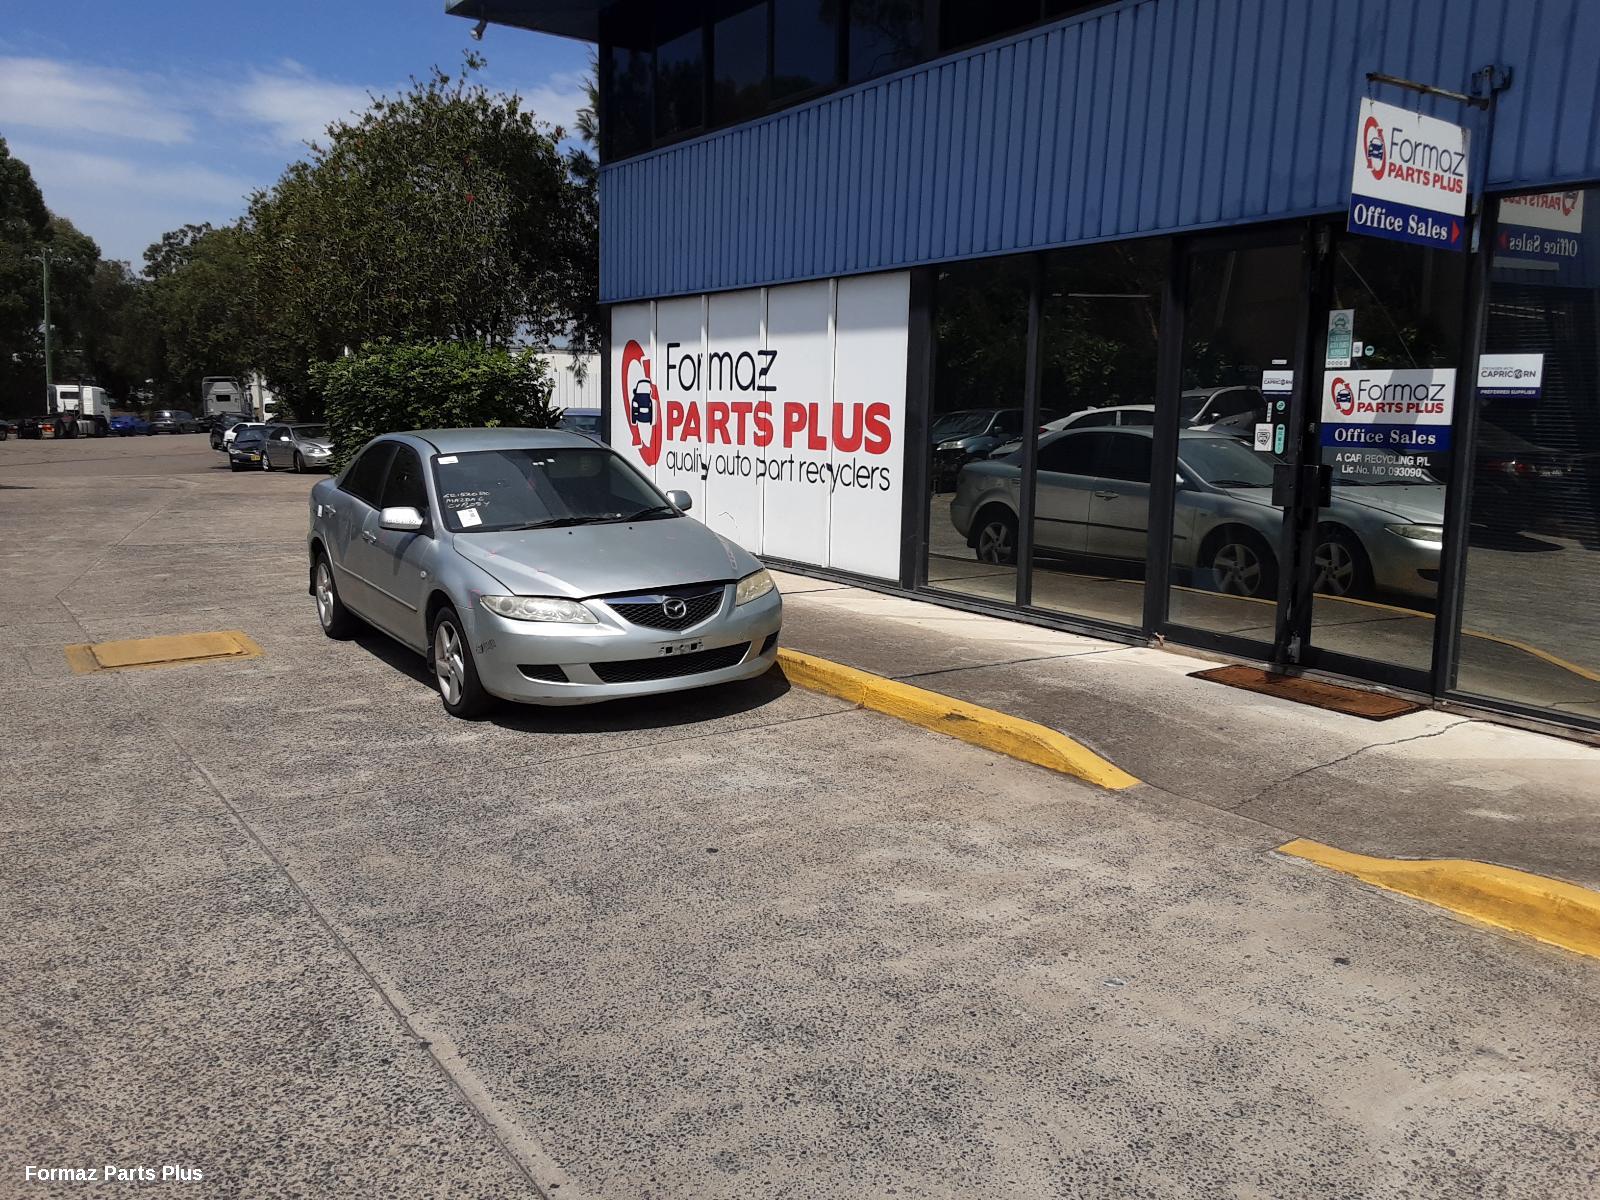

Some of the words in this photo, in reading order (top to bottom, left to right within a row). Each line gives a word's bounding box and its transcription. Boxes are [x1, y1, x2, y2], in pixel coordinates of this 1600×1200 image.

[1390, 127, 1465, 177] Formaz
[1388, 162, 1430, 186] PARTS
[1433, 172, 1463, 194] PLUS
[1354, 204, 1403, 232] Office
[1408, 214, 1448, 240] Sales
[666, 342, 778, 391] Formaz
[1358, 379, 1445, 402] Formaz
[1357, 402, 1403, 413] PARTS
[1406, 402, 1444, 414] PLUS
[666, 401, 774, 447] PARTS
[783, 402, 892, 455] PLUS
[1334, 428, 1384, 443] Office
[1389, 429, 1436, 445] Sales
[666, 448, 712, 481] qualiy
[715, 449, 751, 476] auto
[756, 453, 794, 485] part
[798, 456, 891, 492] recyclers
[1336, 453, 1343, 461] A
[1345, 453, 1362, 462] CAR
[1364, 454, 1414, 465] RECYCLING
[1416, 456, 1431, 467] P/L
